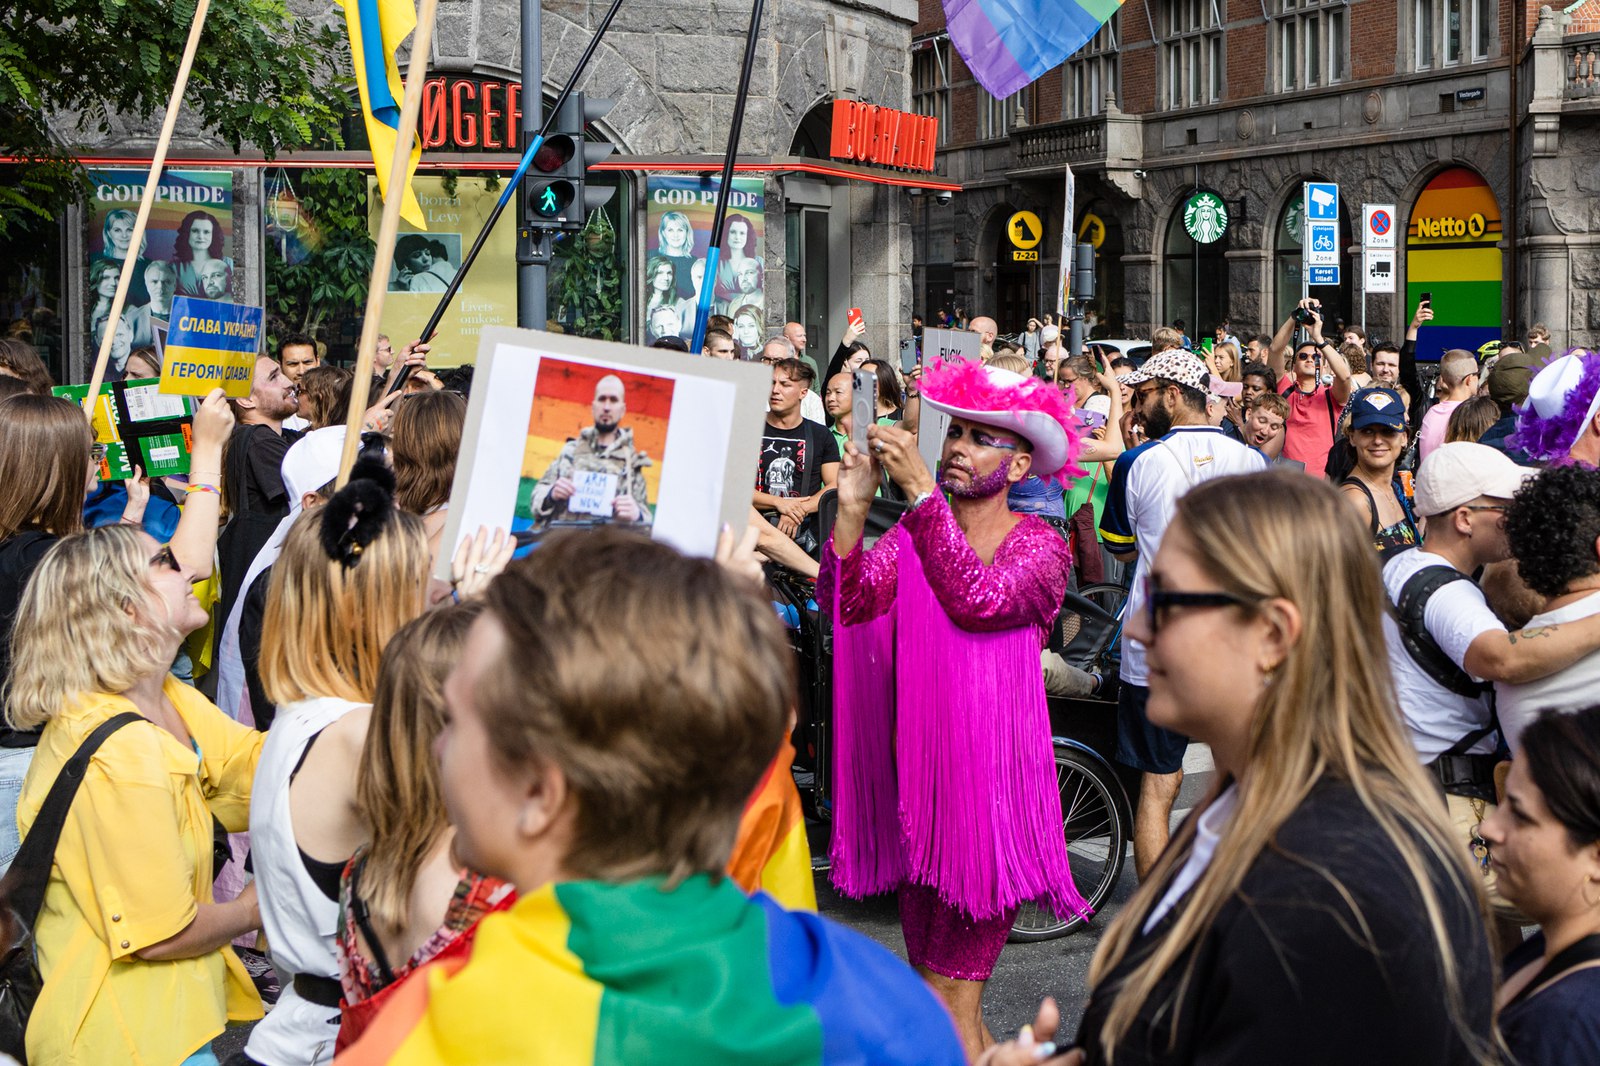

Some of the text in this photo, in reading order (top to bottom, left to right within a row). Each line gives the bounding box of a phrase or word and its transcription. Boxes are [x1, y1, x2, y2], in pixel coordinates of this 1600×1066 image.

[402, 77, 522, 149] ØGE
[97, 184, 225, 203] GOD PRIDE
[654, 188, 696, 205] GOD
[429, 208, 462, 226] Levy
[1418, 217, 1466, 237] Netto
[1016, 252, 1036, 260] 7-24
[461, 300, 494, 312] Livets
[178, 316, 221, 335] СЛАВА
[940, 347, 962, 364] FUCK
[170, 362, 251, 381] ГЕРОЯМ СЛАВА!
[584, 472, 607, 486] ARM
[770, 471, 782, 482] 23
